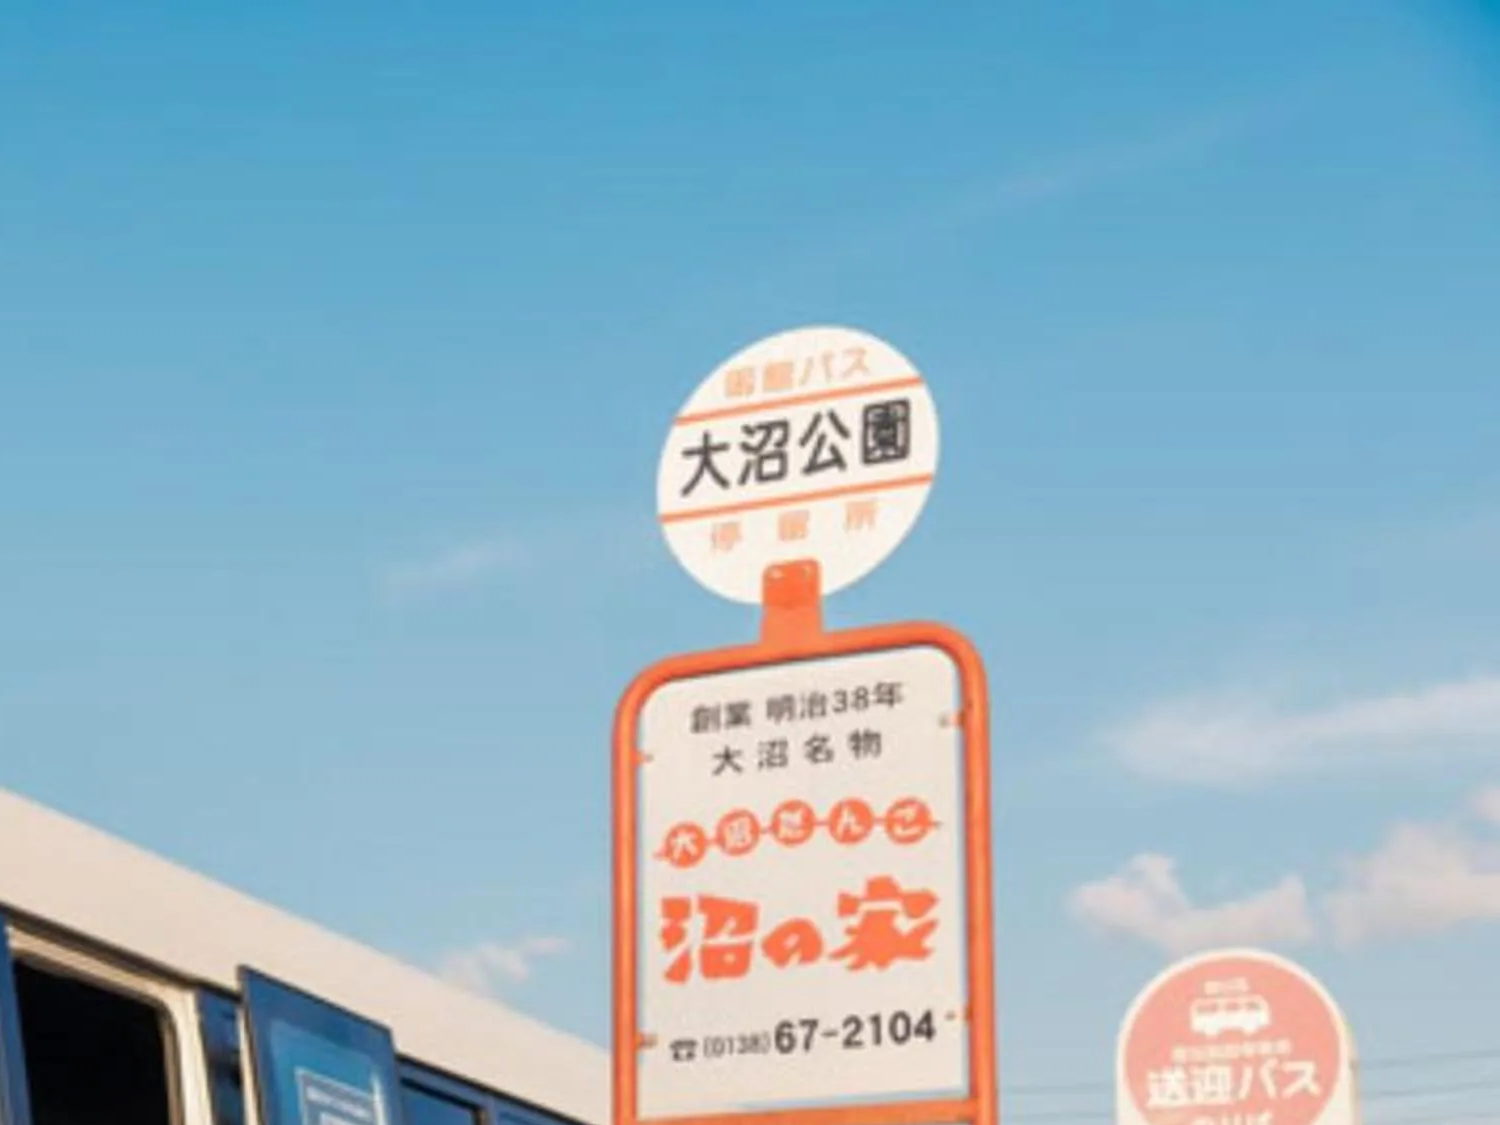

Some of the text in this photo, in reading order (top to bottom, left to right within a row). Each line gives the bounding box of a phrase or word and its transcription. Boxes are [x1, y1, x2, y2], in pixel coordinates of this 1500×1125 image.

[680, 398, 911, 498] 大沼公園
[711, 727, 883, 777] 大沼名物
[660, 875, 940, 985] 沼の家
